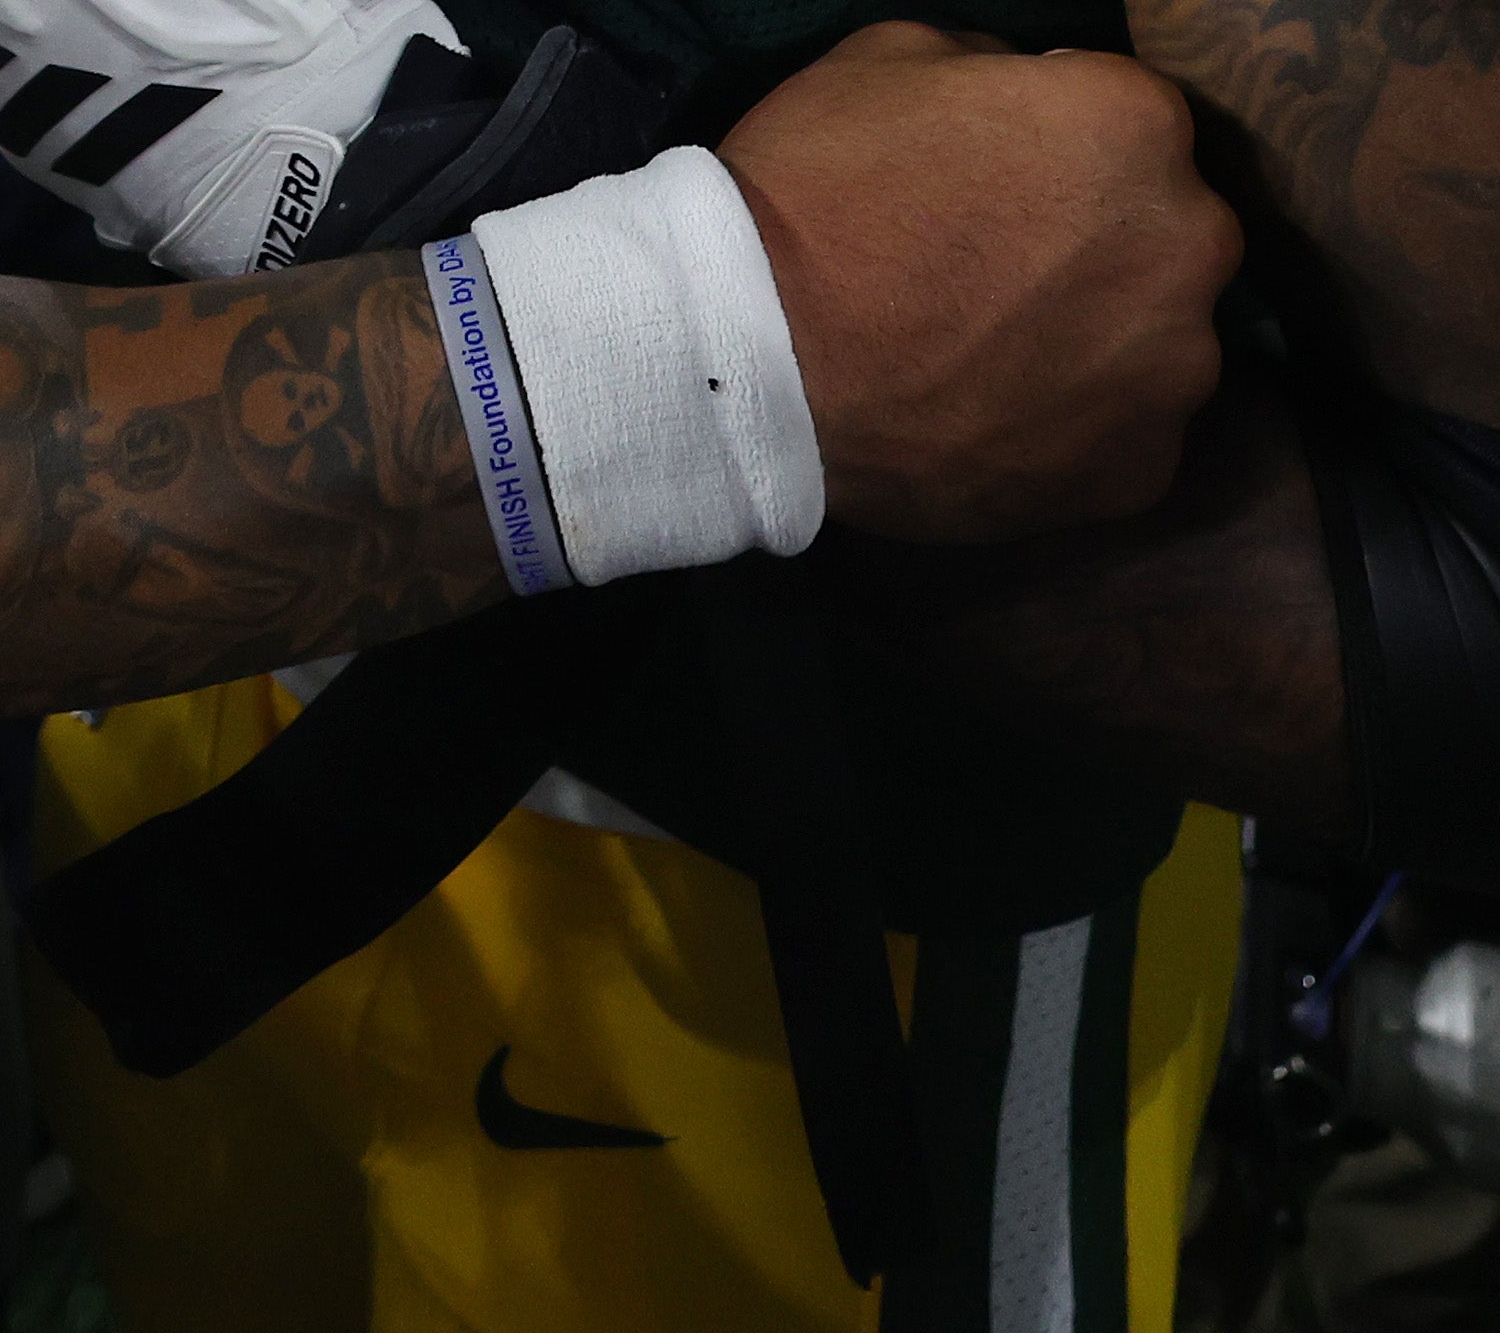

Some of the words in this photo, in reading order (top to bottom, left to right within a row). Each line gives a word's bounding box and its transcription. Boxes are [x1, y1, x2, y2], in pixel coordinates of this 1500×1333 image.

[255, 152, 321, 272] DIZERO
[448, 276, 476, 306] by
[458, 310, 518, 473] Foundation
[496, 479, 540, 556] FINISH
